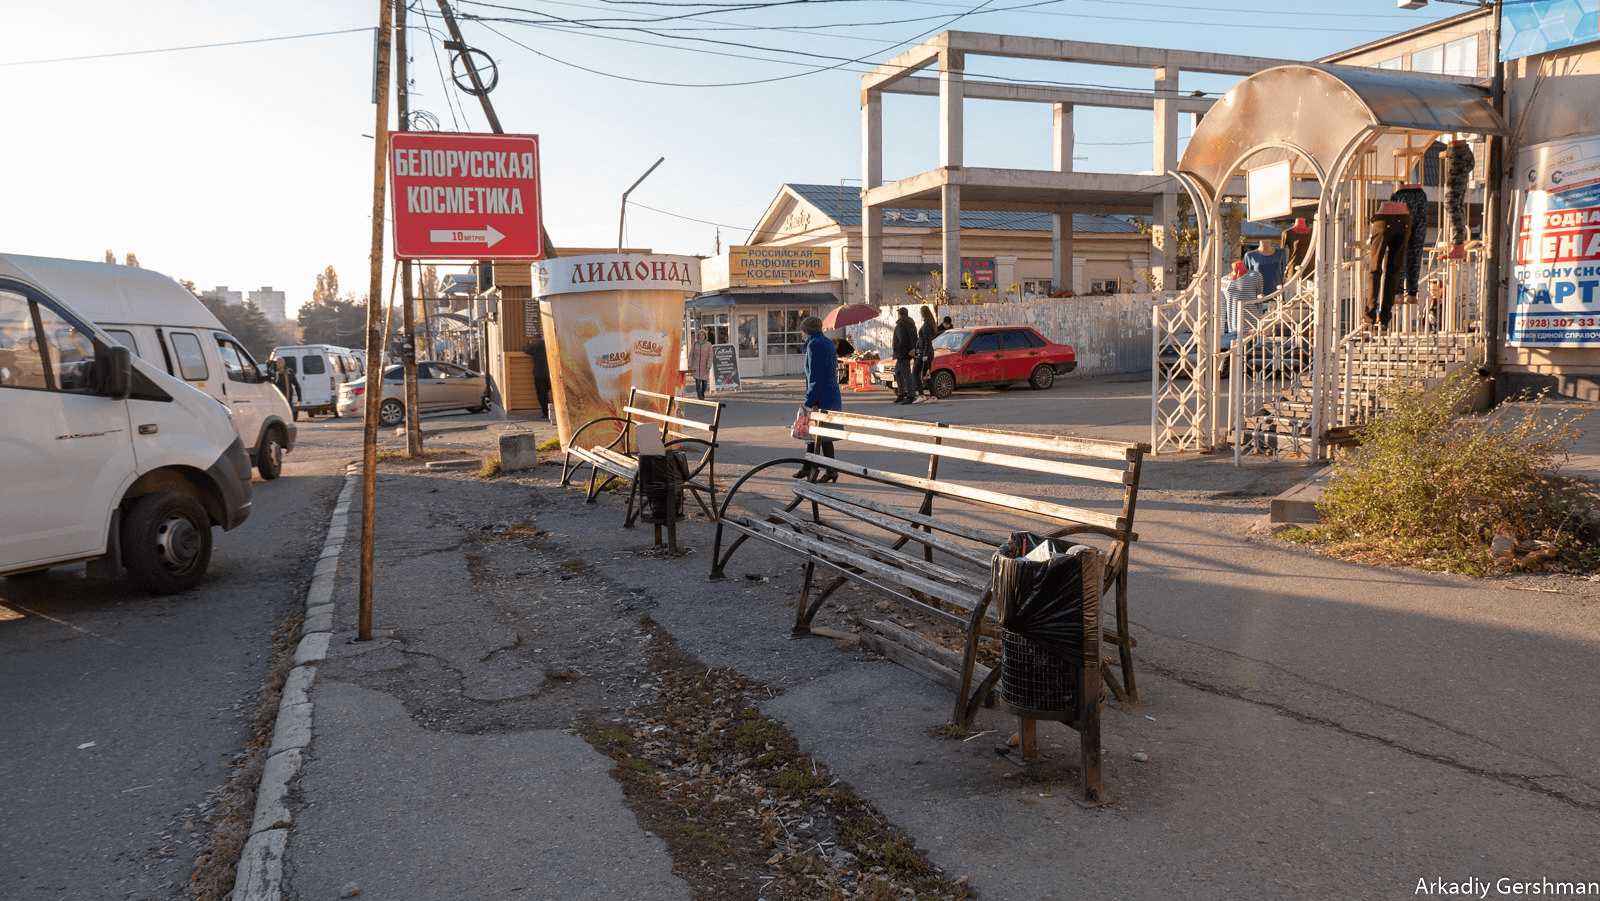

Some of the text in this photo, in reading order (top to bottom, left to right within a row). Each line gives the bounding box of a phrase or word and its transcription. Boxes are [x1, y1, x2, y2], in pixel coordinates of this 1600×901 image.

[395, 148, 534, 179] БЕЛОРУССКАЯ
[407, 185, 524, 215] КОСМЕТИКА
[1523, 210, 1600, 231] ГОДНА
[452, 231, 463, 241] 10
[748, 247, 813, 257] РОССИЙСКАЯ
[740, 258, 821, 268] ПАРФЮМЕРИЯ
[571, 260, 692, 286] ЛИМОНАД
[747, 269, 816, 279] КОСМЕТИКА
[1517, 270, 1531, 280] ПО
[1517, 280, 1599, 305] КАРТ
[1527, 318, 1551, 329] (928)
[1552, 318, 1575, 328] 307
[1578, 318, 1595, 327] 33
